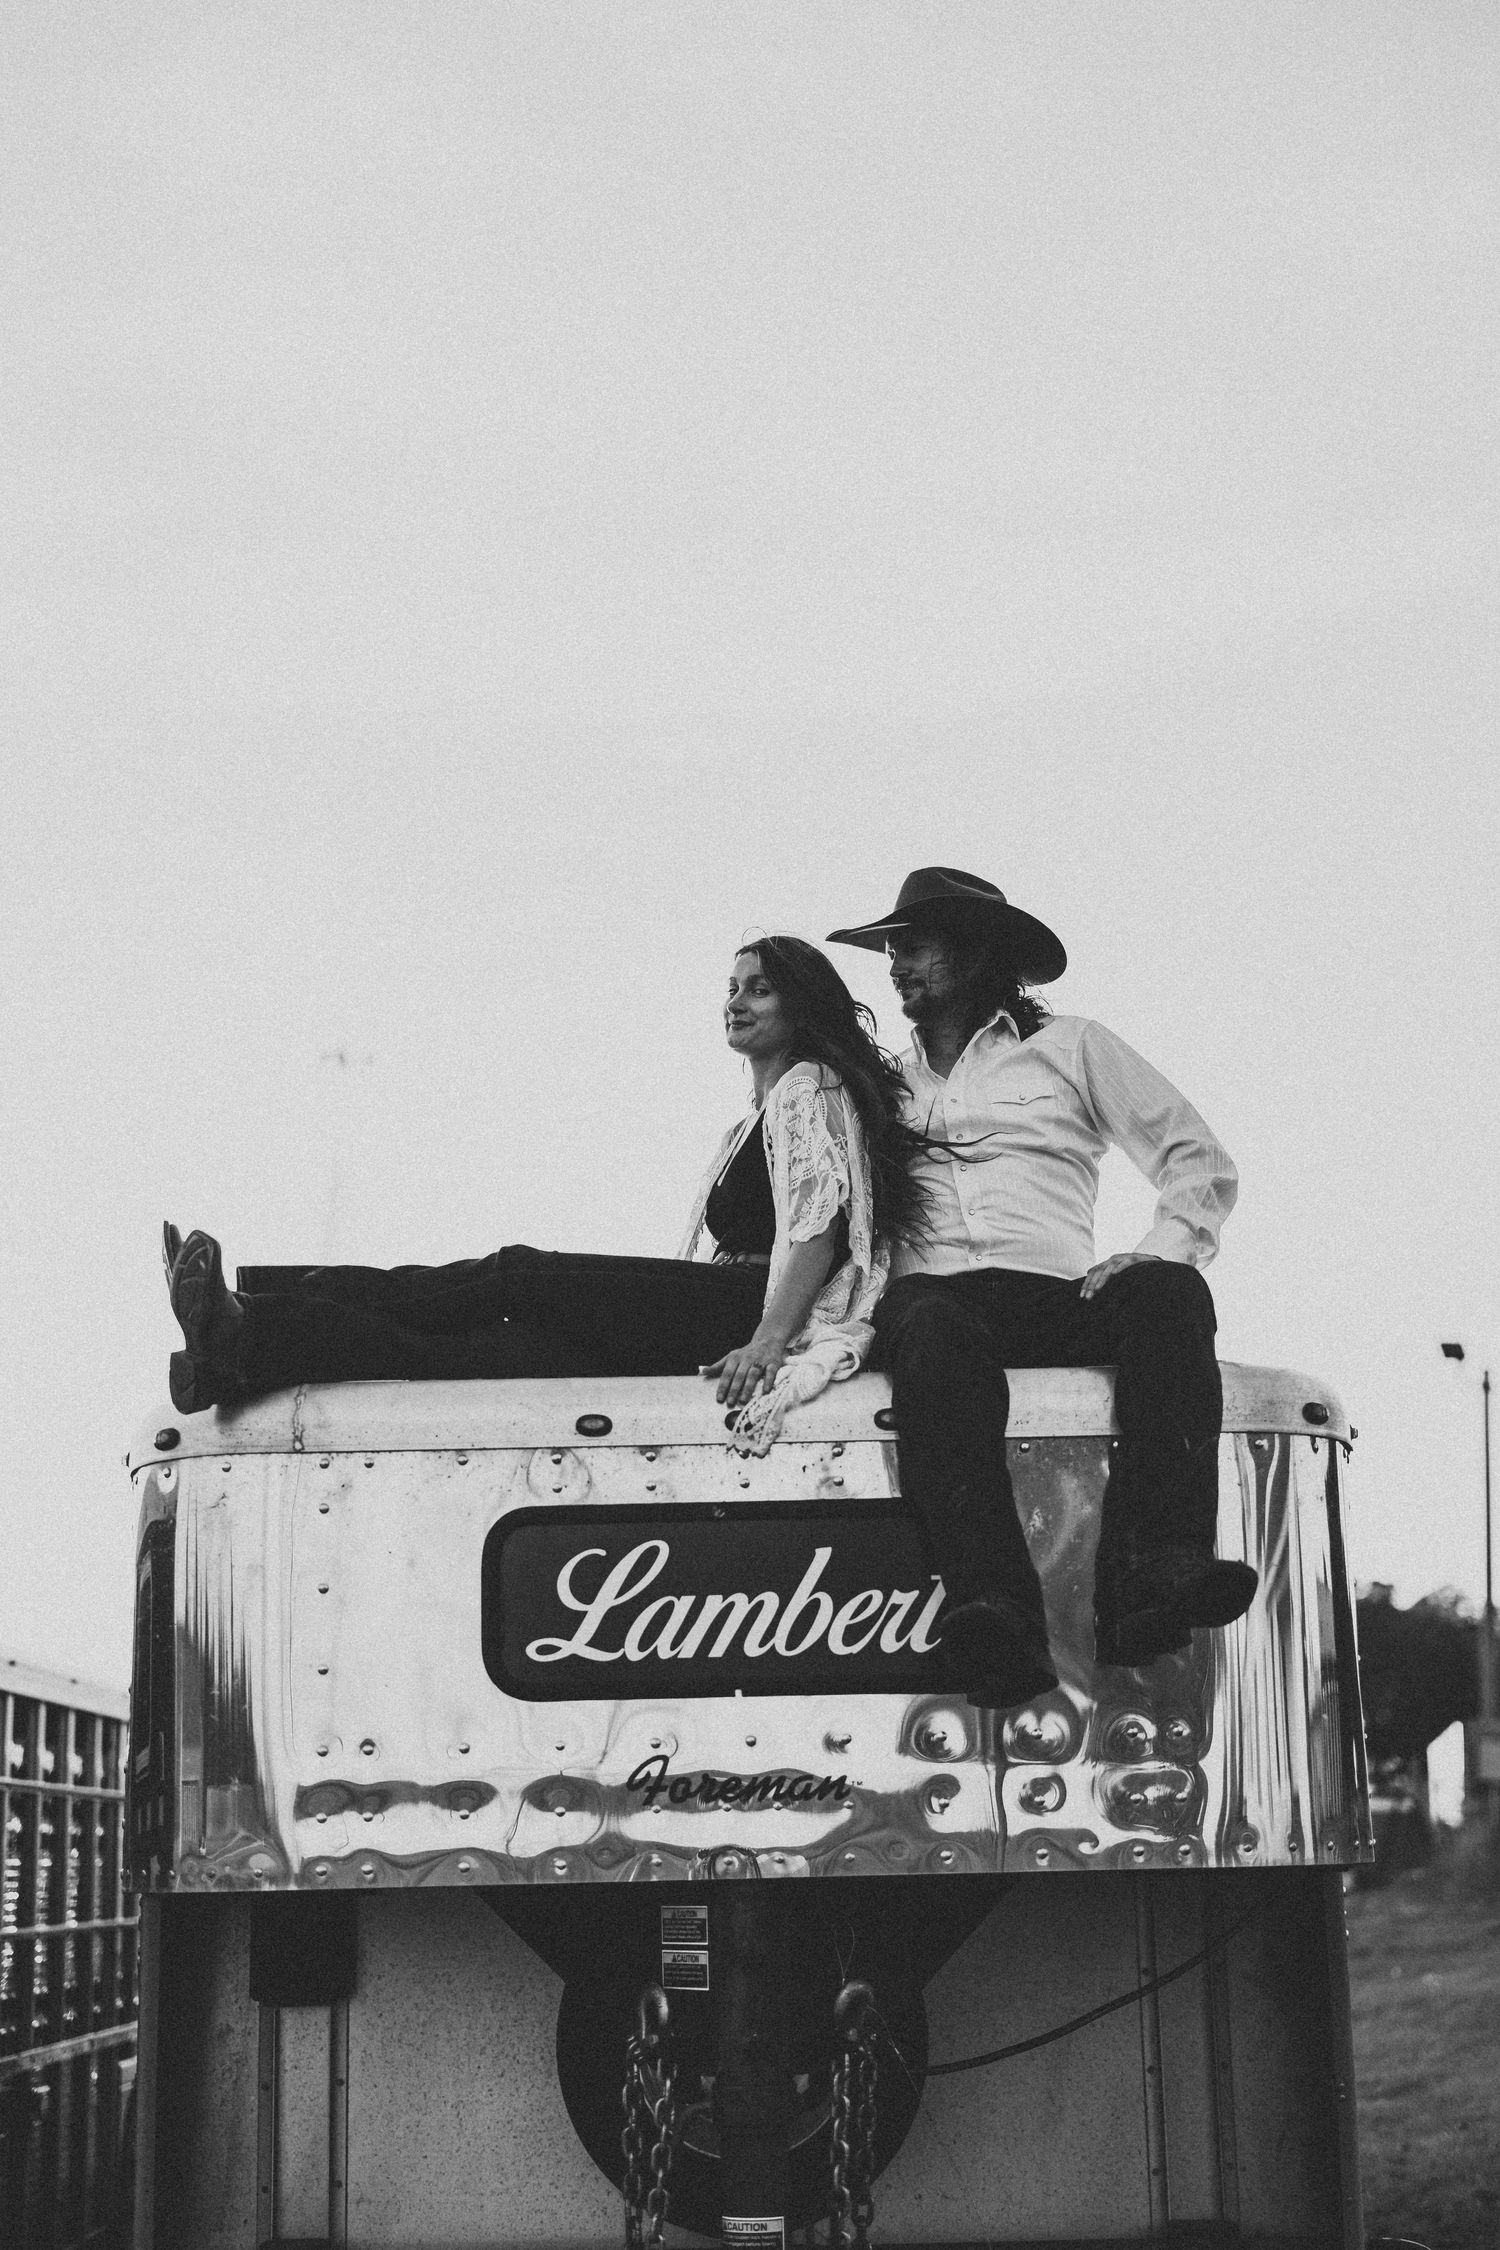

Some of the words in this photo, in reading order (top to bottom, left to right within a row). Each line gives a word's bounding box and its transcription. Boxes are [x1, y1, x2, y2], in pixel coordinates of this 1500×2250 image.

[625, 1754, 852, 1806] Foreman
[677, 1954, 700, 1964] CAUTION
[727, 2221, 768, 2232] CAUTION
